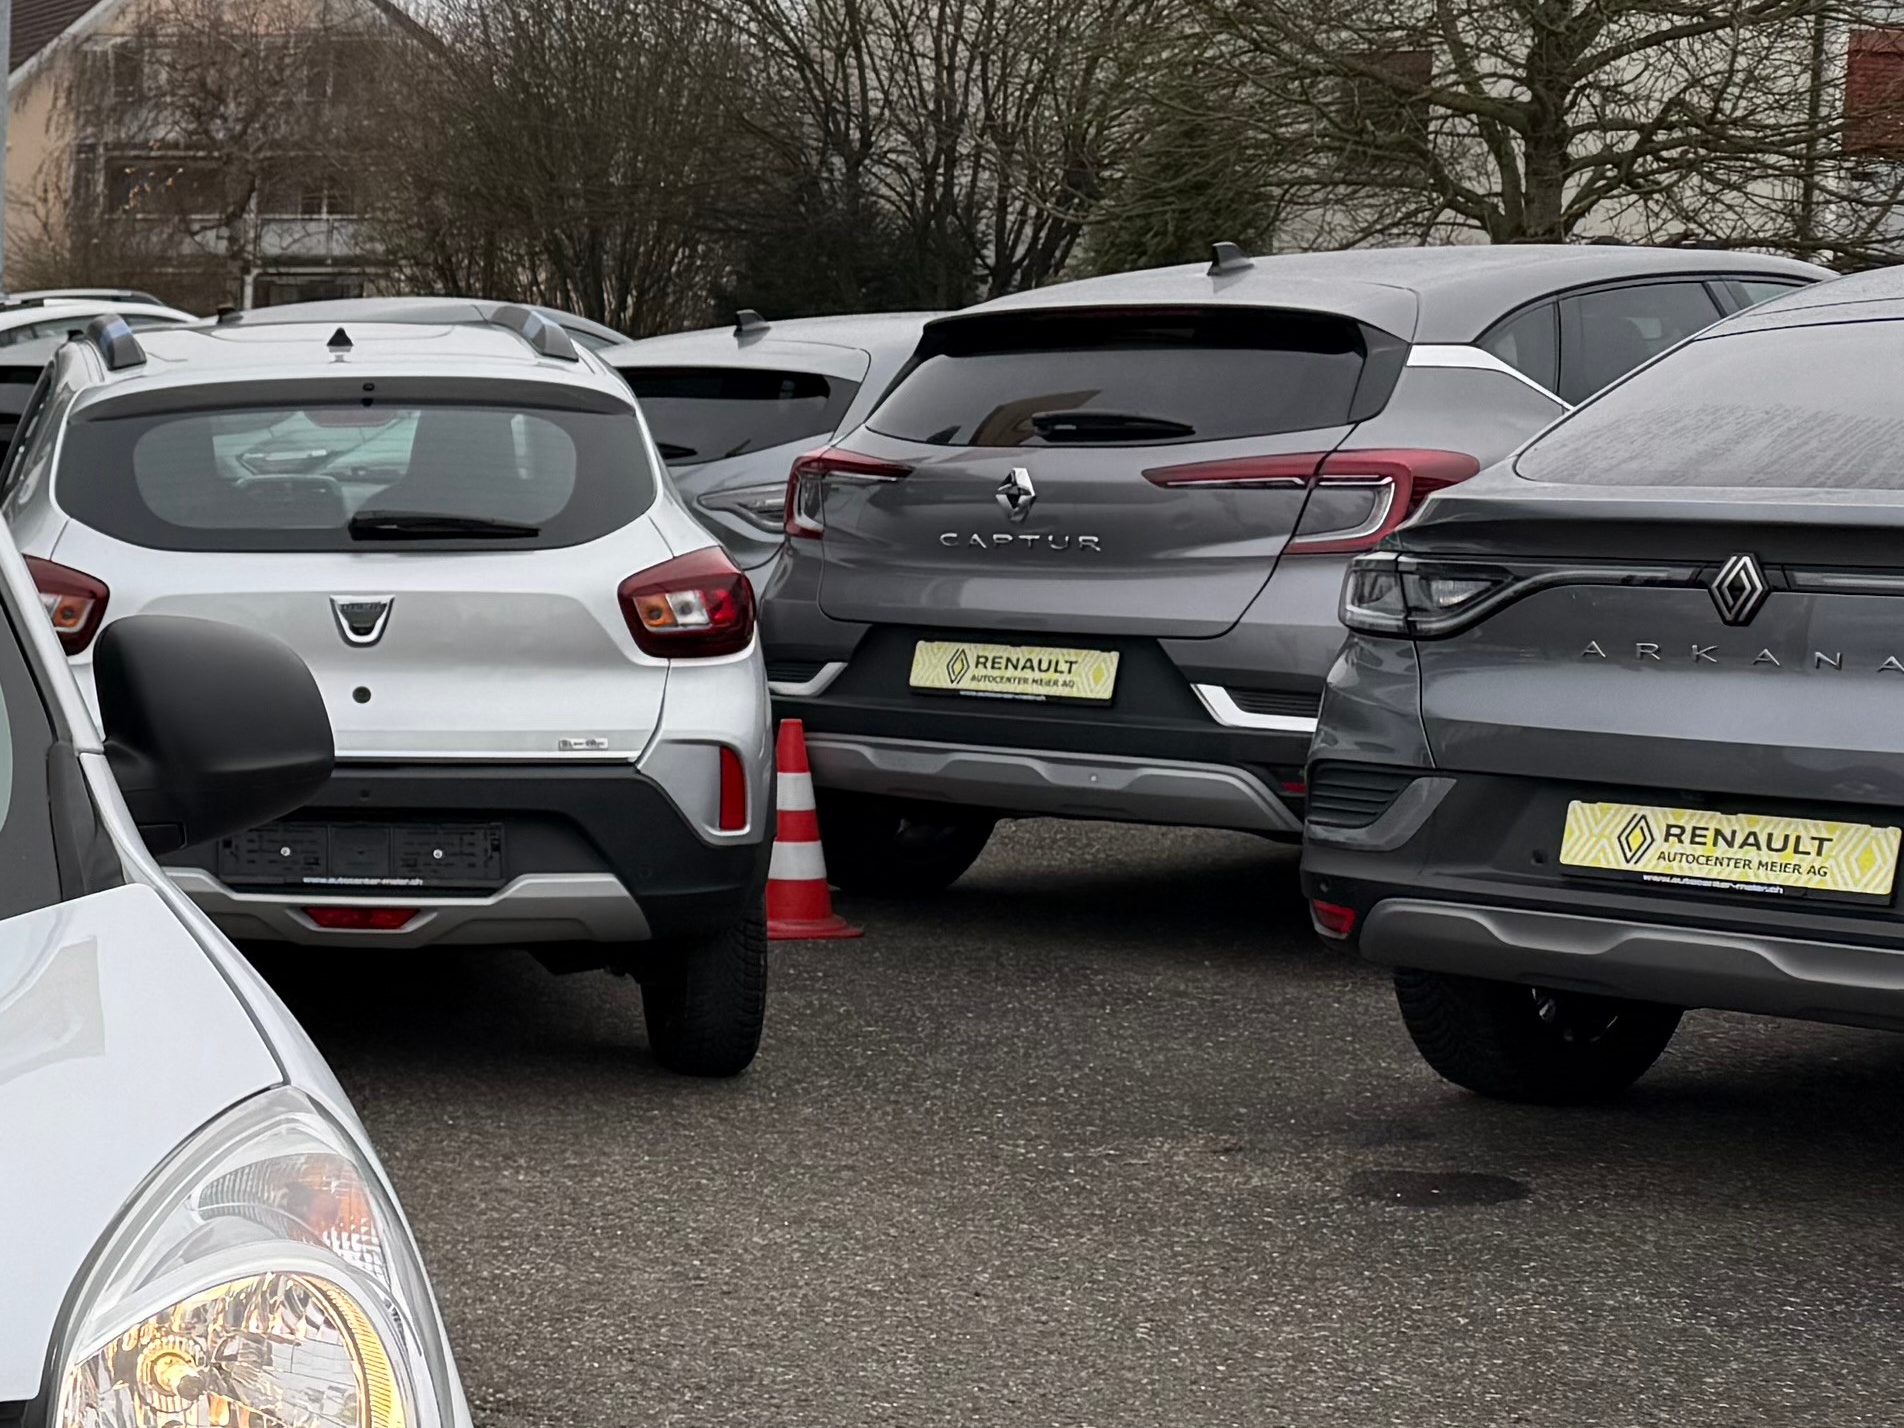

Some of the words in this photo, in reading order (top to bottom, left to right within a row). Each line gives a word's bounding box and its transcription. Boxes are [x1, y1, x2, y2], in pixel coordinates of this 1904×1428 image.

[939, 532, 1101, 552] CAPTUR
[974, 654, 1079, 676] RENAULT
[1579, 640, 1904, 673] ARKANA
[970, 674, 1030, 686] AUTOCENTER
[1663, 823, 1834, 858] RENAULT
[1657, 850, 1752, 871] AUTOCENTER
[1757, 860, 1802, 876] MEIER
[1806, 864, 1829, 878] AG
